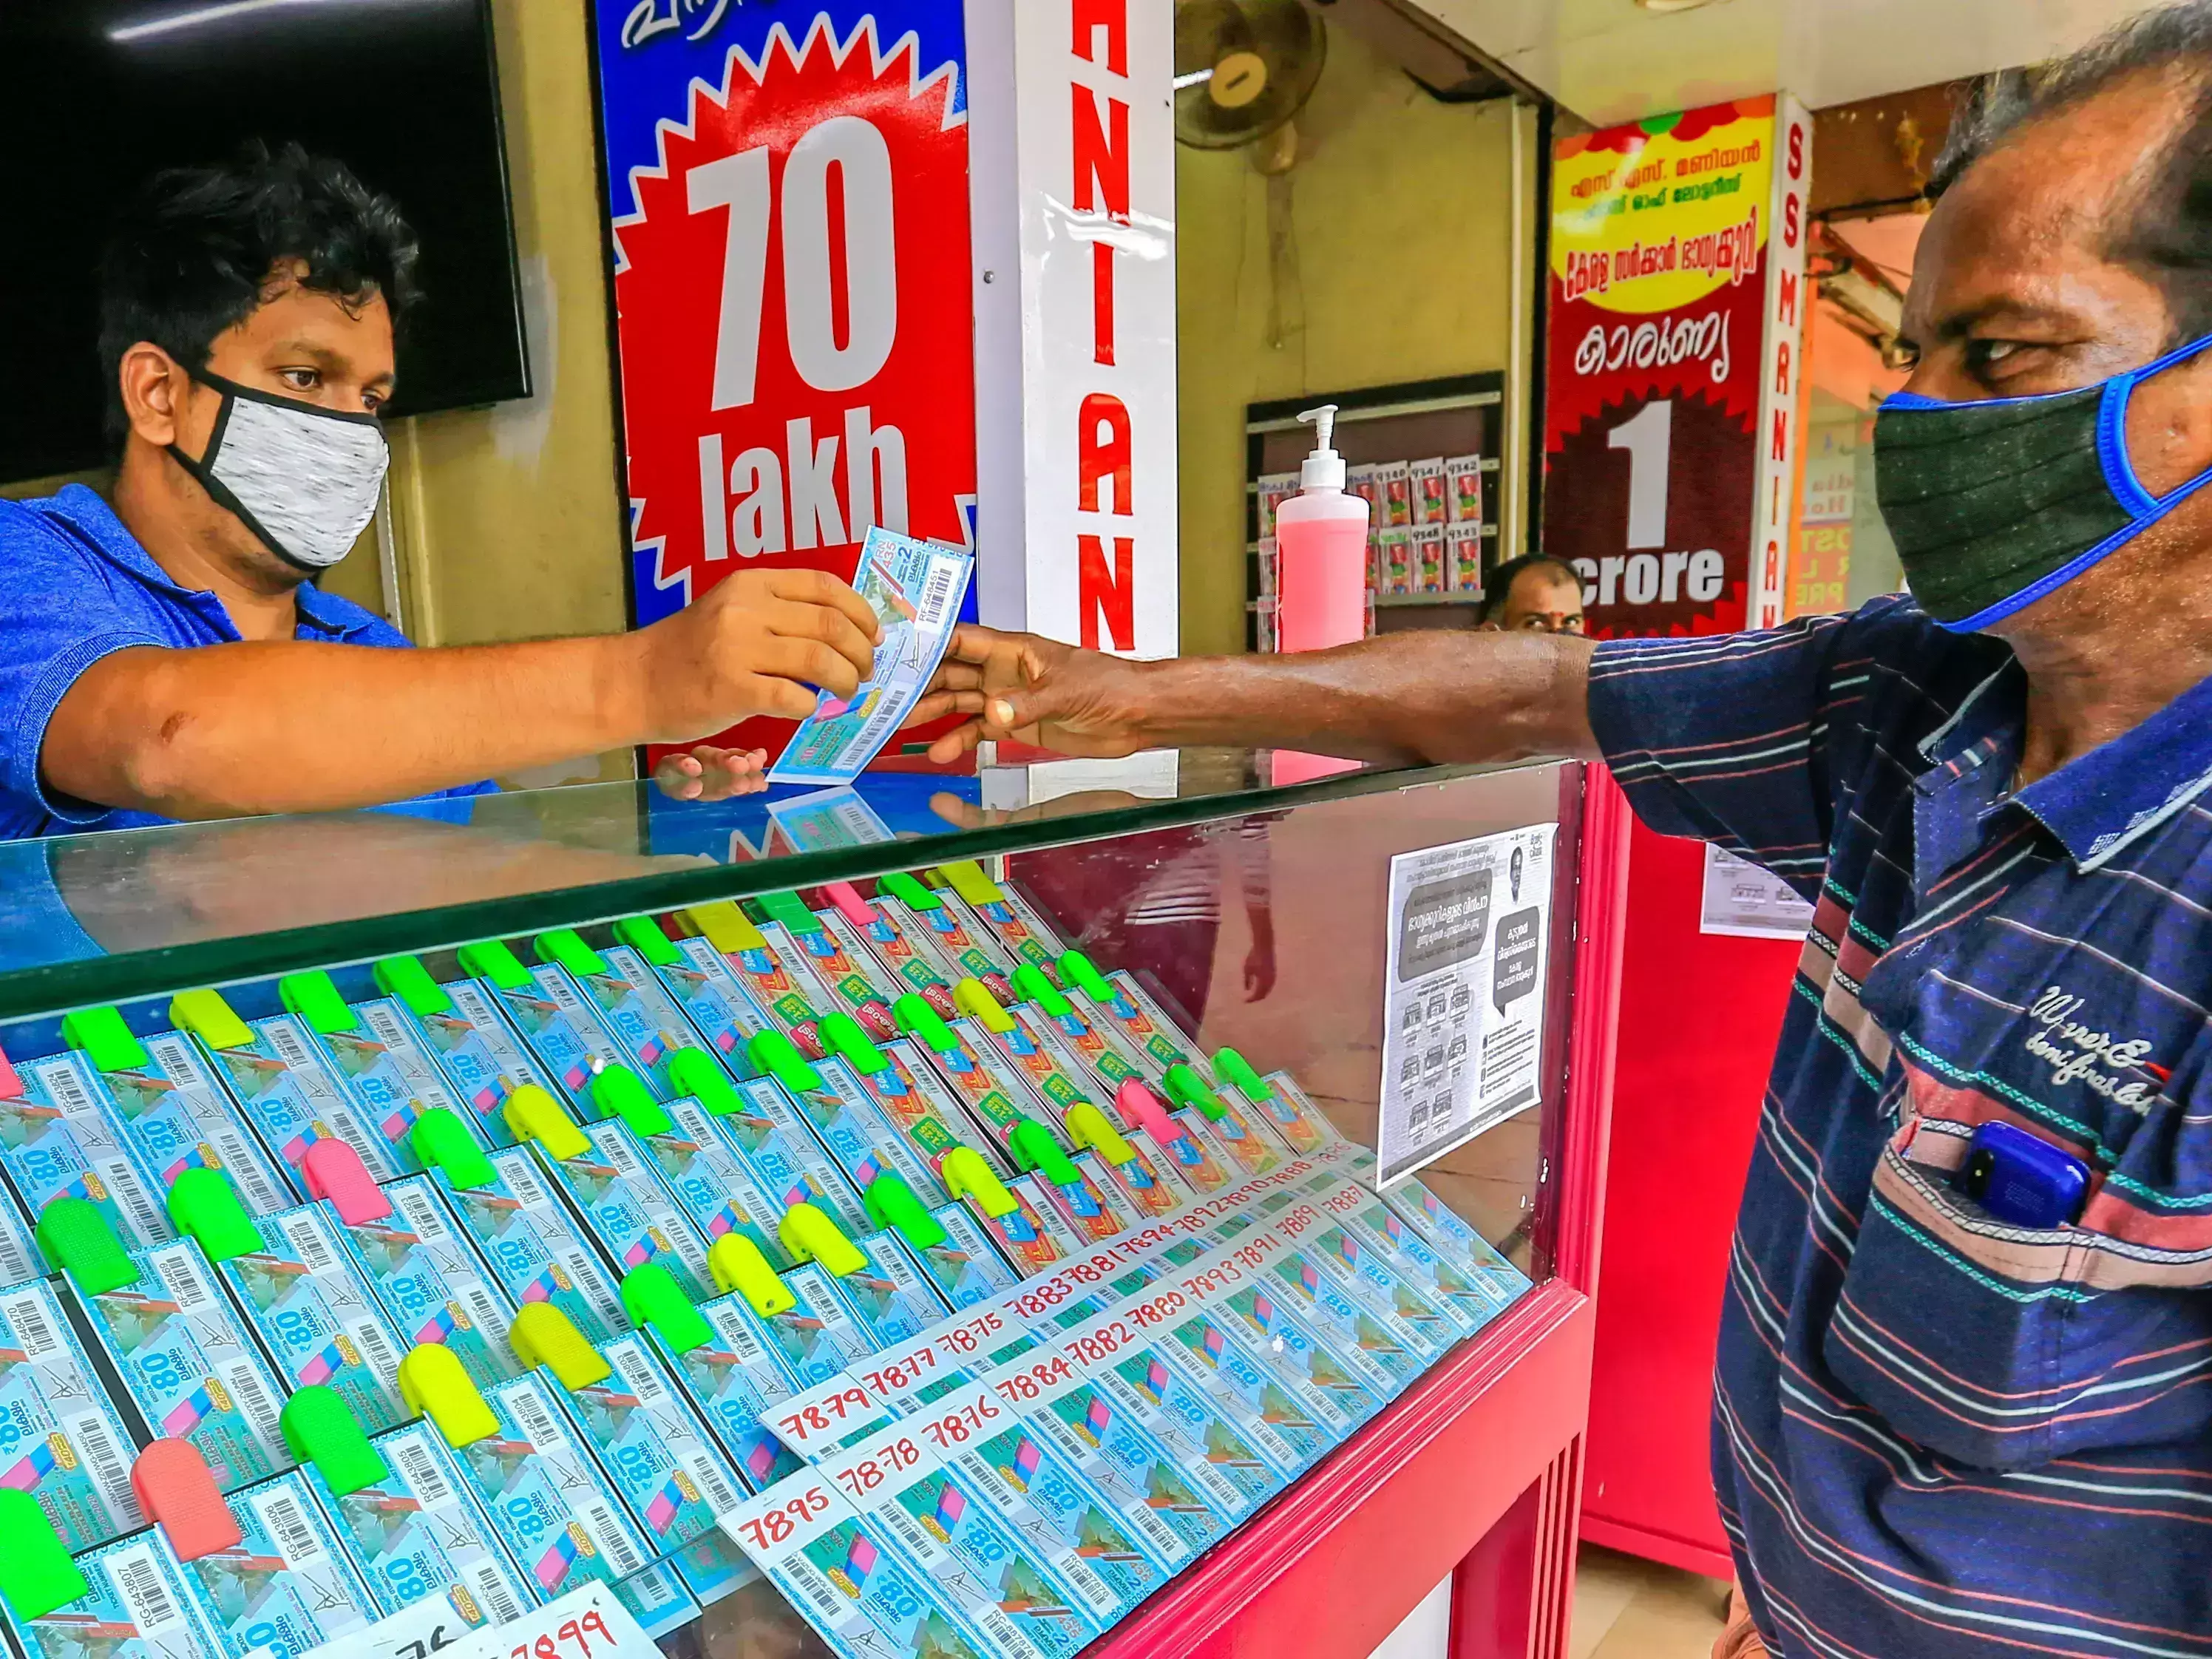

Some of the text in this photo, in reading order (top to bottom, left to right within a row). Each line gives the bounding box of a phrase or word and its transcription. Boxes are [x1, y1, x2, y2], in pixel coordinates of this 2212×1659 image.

[685, 115, 898, 412] 70
[1574, 308, 1731, 384] കാരുണ്യ
[697, 405, 909, 561] lakh
[1607, 399, 1673, 549] 1
[918, 570, 938, 622] RF-648451
[1572, 547, 1726, 606] crore
[1170, 1197, 1227, 1233] 7892
[1220, 1180, 1266, 1207] 7890
[1113, 1224, 1178, 1256] 7894
[1233, 1232, 1283, 1271] 7891
[160, 1261, 190, 1308] RF-648469
[1059, 1249, 1128, 1286] 7881
[1180, 1259, 1244, 1302] 7893
[1002, 1276, 1073, 1320] 7883
[1123, 1289, 1187, 1329] 7880
[7, 1306, 39, 1356] RF-648470
[934, 1312, 1004, 1355] 7875
[1062, 1321, 1136, 1369] 7882
[139, 1347, 185, 1402] ₹80
[861, 1347, 937, 1395] 7877
[994, 1356, 1073, 1404] 7884
[512, 1397, 546, 1447] RG-643804
[778, 1387, 872, 1441] 7879
[920, 1394, 1000, 1449] 7876
[398, 1449, 433, 1502] RG-643805
[835, 1437, 920, 1498] 7878
[264, 1504, 302, 1561] RG-643806
[505, 1493, 551, 1547] ₹80
[737, 1486, 830, 1550] 7895
[92, 1562, 121, 1608] TICKET NUMBER
[117, 1565, 156, 1628] RG-643807
[1068, 1553, 1110, 1597] RC-887876
[991, 1609, 1036, 1656] RC-887878
